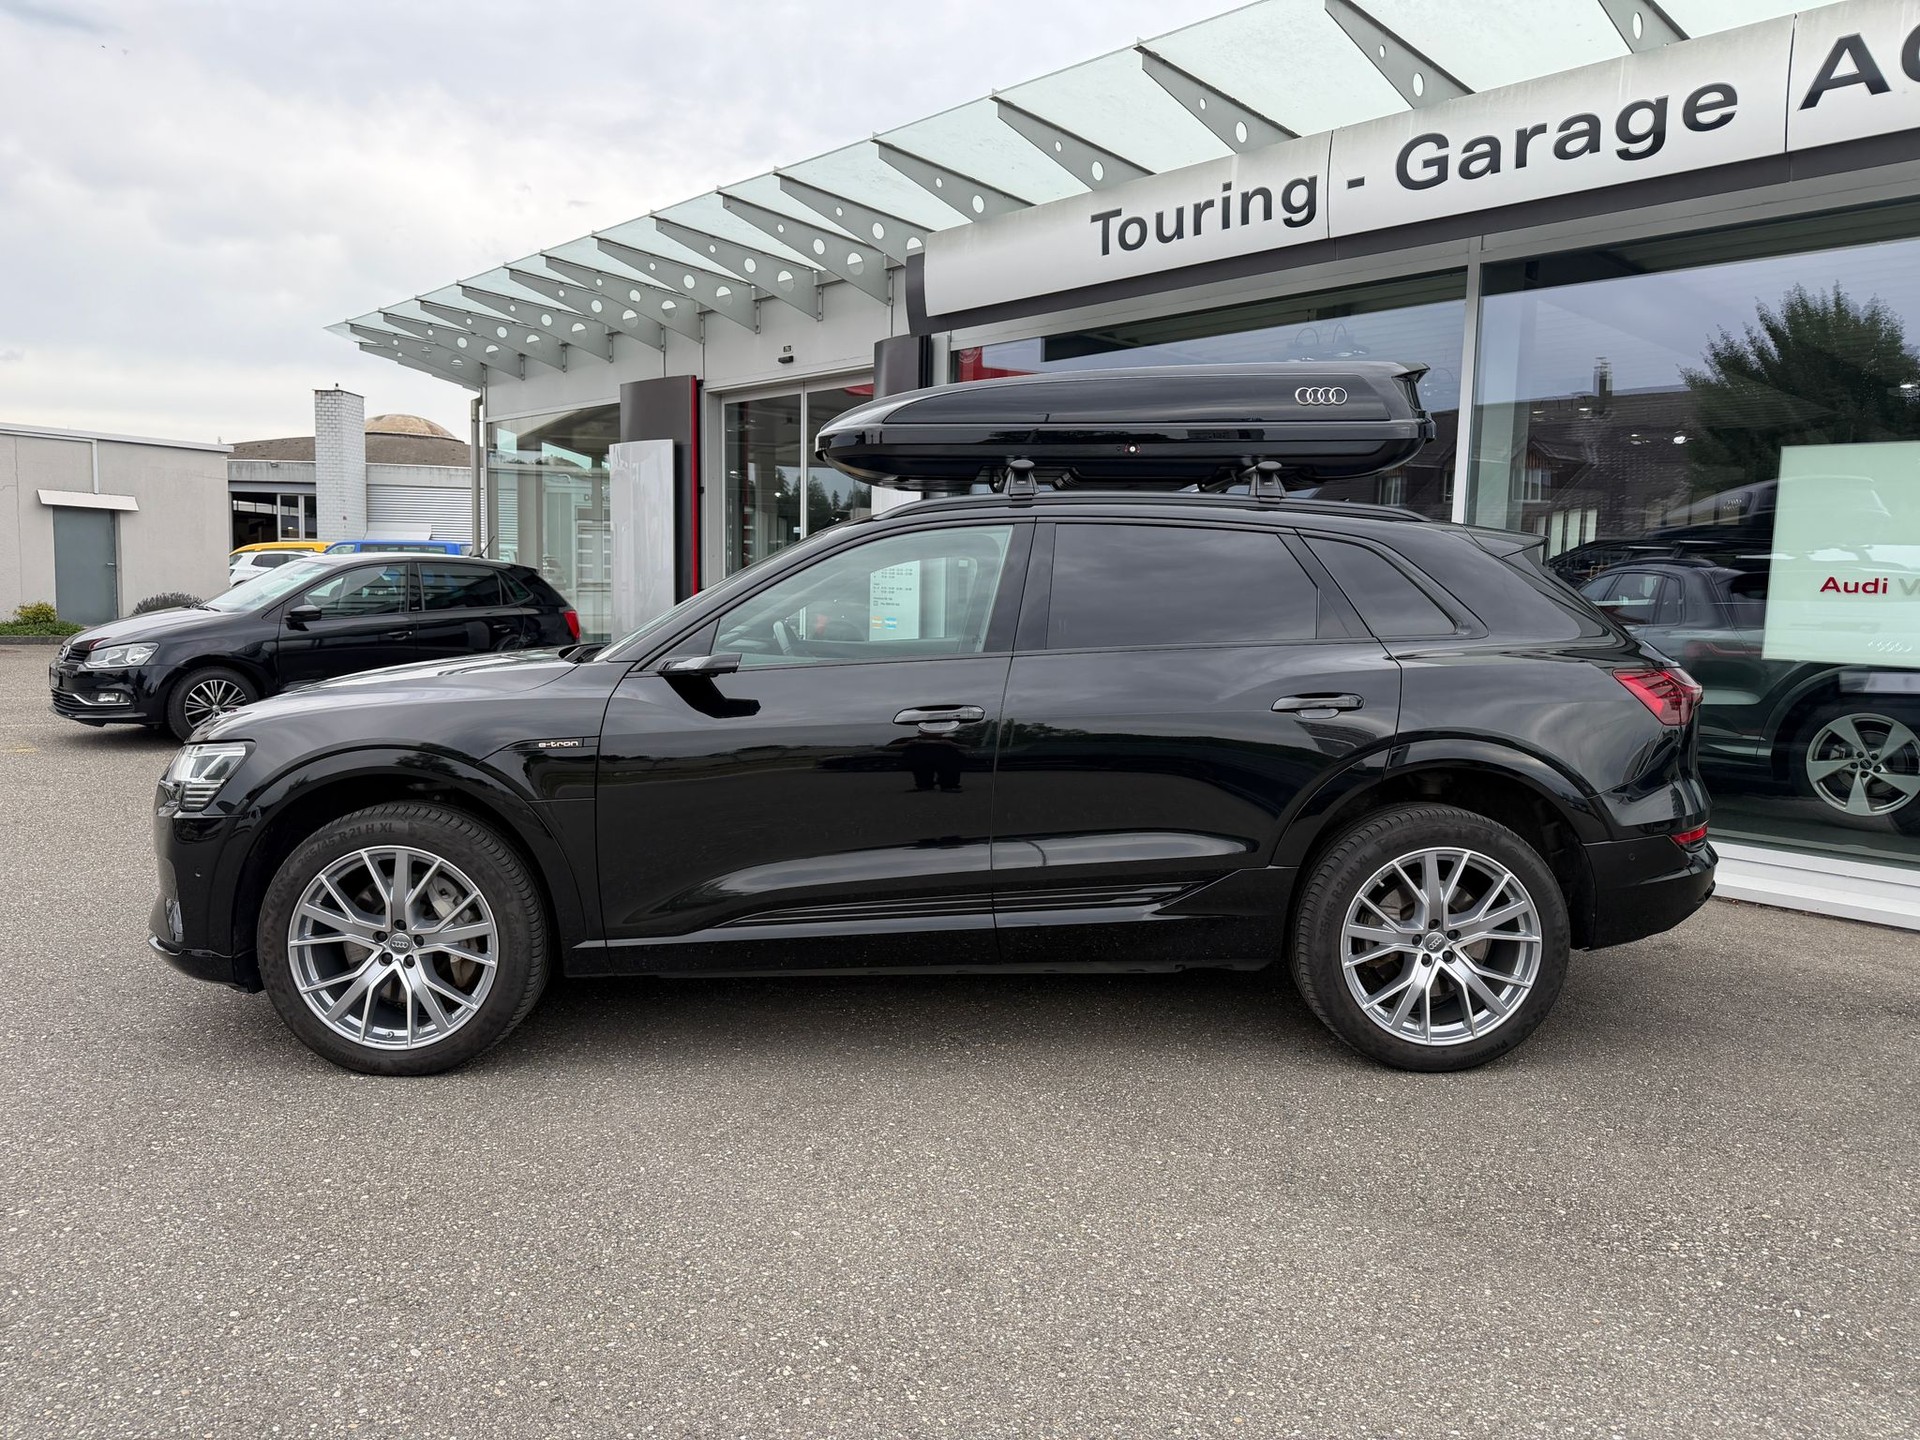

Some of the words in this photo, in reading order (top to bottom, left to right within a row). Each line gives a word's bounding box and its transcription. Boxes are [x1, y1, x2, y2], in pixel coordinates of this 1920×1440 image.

[1090, 175, 1318, 256] Touring
[1395, 81, 1739, 191] Garage
[1819, 576, 1889, 595] Audi
[1898, 578, 1920, 597] V
[538, 740, 579, 749] e-tron
